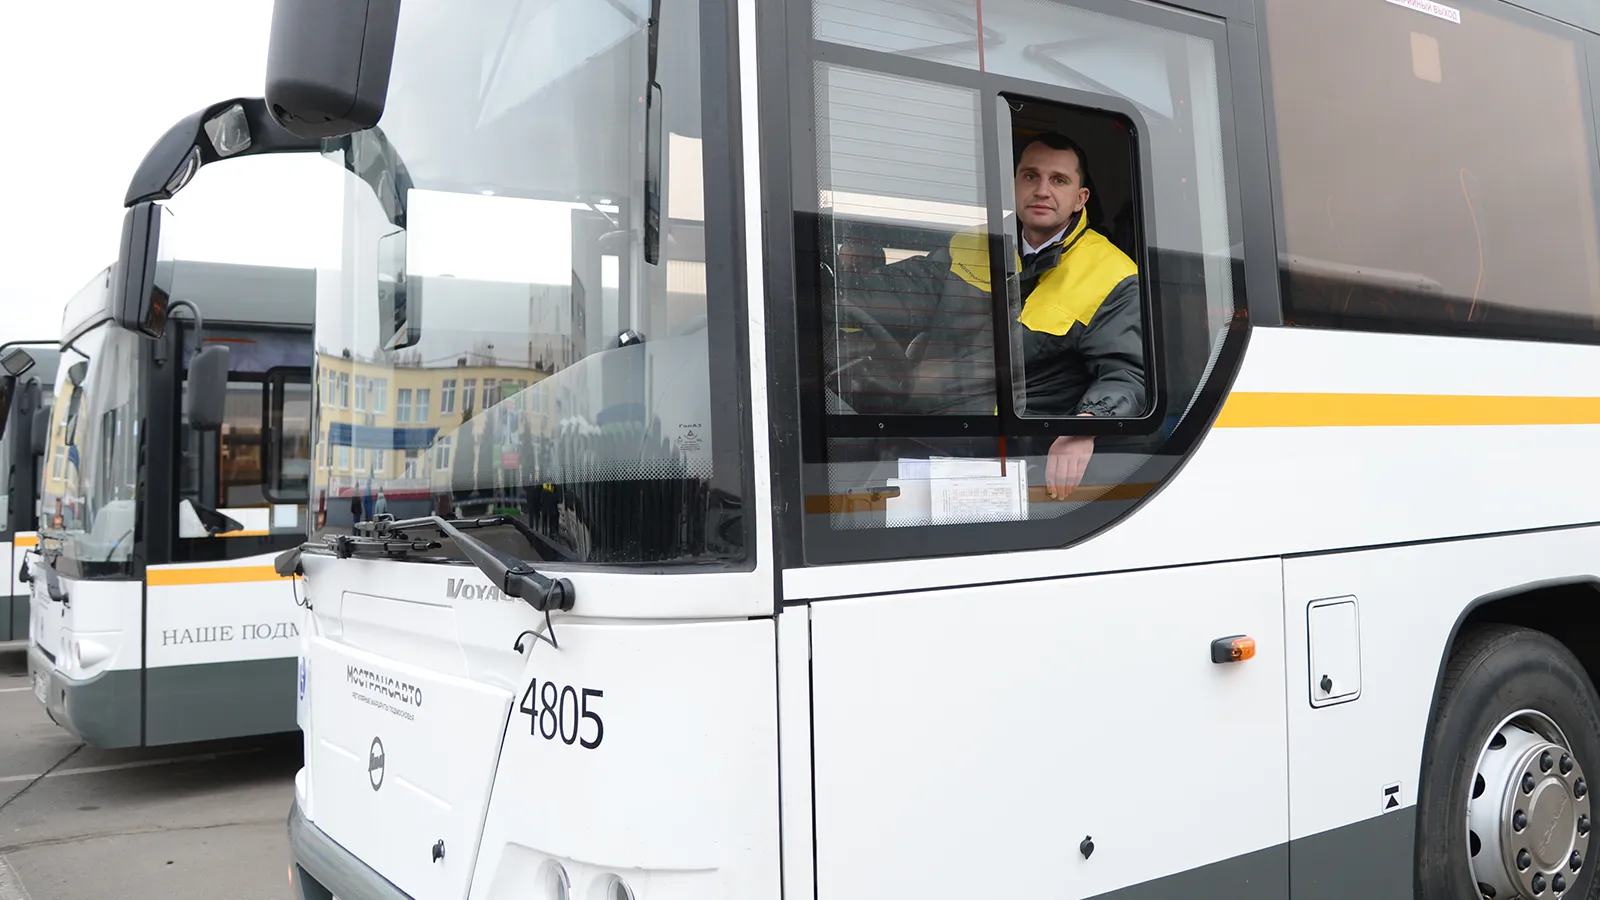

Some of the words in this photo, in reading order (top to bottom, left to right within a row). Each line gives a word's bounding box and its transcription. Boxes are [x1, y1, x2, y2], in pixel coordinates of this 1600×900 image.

[1433, 5, 1458, 20] ВЫХОД
[162, 625, 234, 646] НАШЕ
[347, 664, 422, 707] МОСТРАНСАВТО
[520, 677, 604, 750] 4805
